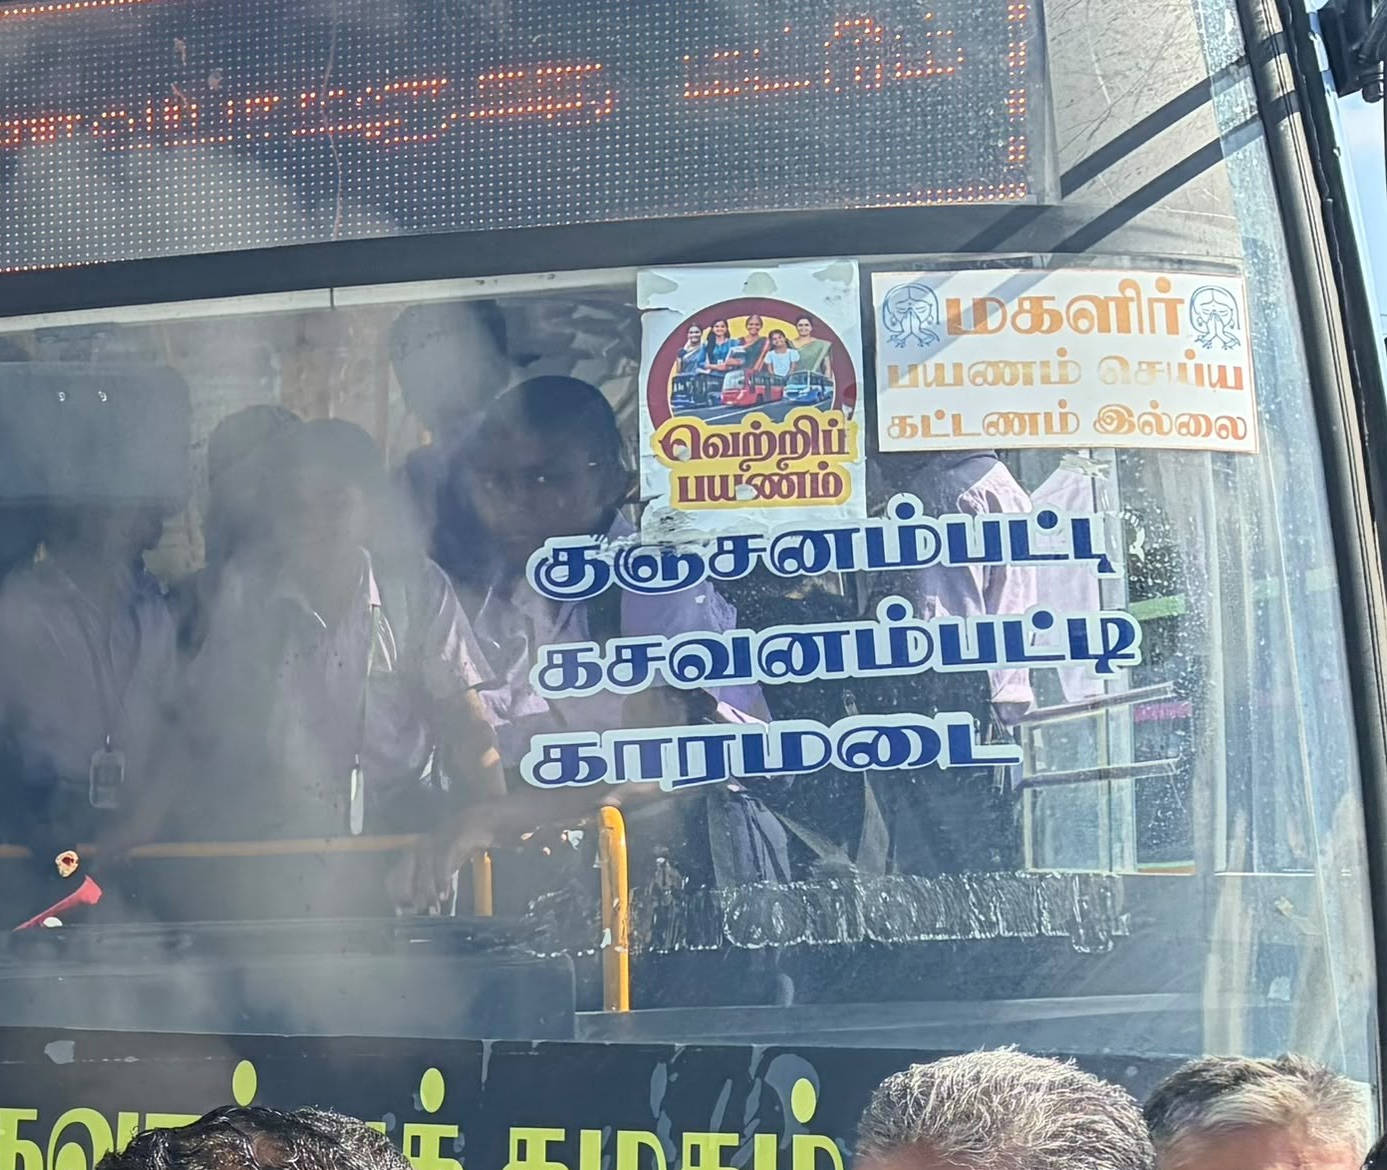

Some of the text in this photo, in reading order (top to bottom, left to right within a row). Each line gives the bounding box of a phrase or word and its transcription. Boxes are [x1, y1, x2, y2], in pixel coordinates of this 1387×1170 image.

[944, 277, 1186, 337] மகளிர்
[887, 347, 1244, 391] பயணம் செய்ய
[658, 414, 850, 472] வெற்றிப்
[887, 398, 1247, 441] கட்டணம் இல்லை
[677, 460, 843, 502] பயணம்
[533, 600, 1139, 694] கசவனம்பட்டி
[529, 720, 1022, 788] காரமடை
